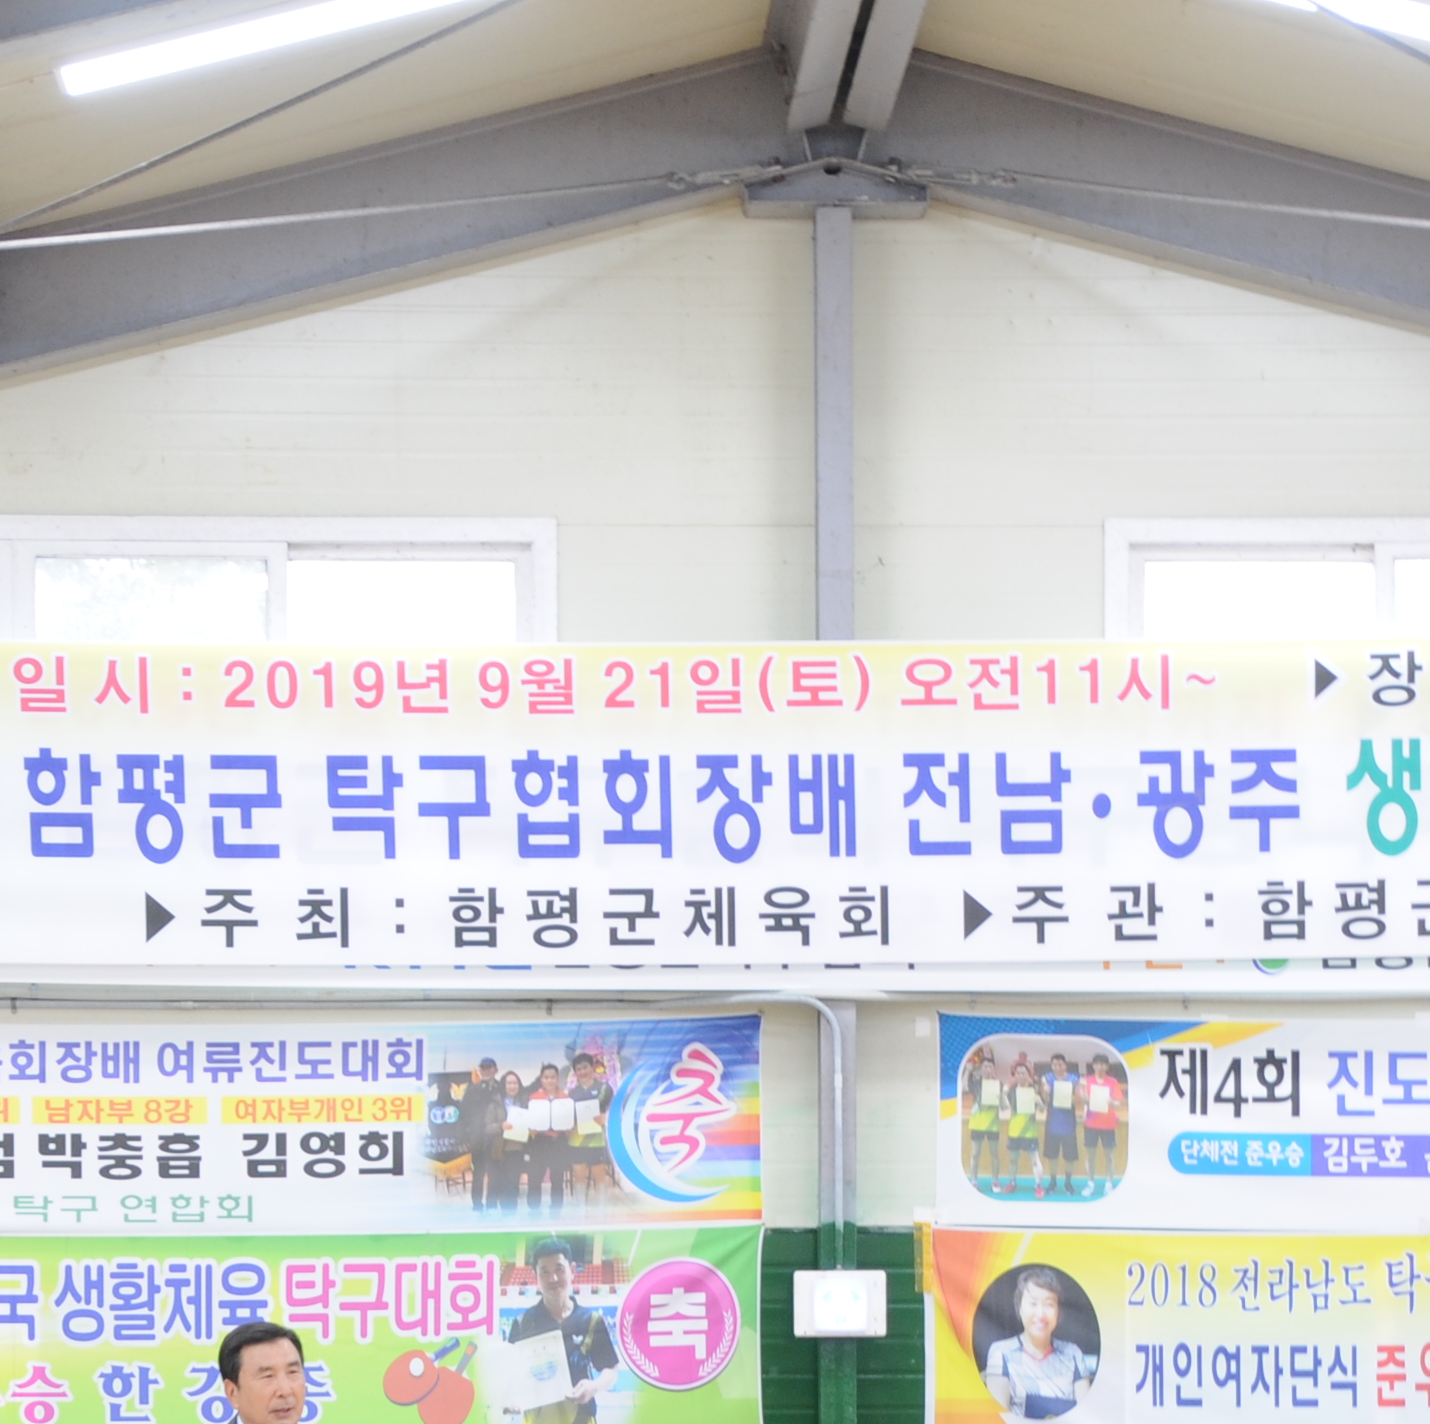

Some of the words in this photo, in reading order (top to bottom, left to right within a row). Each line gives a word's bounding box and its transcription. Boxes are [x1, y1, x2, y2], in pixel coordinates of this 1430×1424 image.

[223, 657, 451, 715] 2019년
[478, 656, 576, 715] 9월
[603, 654, 873, 715] 21일(토)
[23, 747, 283, 865] 함평군
[325, 748, 858, 865] 탁구협회장배
[902, 748, 1301, 859] 전남·광주
[447, 882, 892, 950] 함평군체육회
[156, 1037, 425, 1084] 여류진도대회
[1159, 1046, 1302, 1119] 제4회
[44, 1097, 135, 1124] 남자부
[143, 1098, 193, 1124] 8강
[234, 1096, 363, 1123] 여자부개인
[371, 1096, 414, 1122] 3위
[645, 1042, 729, 1172] 축
[37, 1131, 203, 1181] 박충흡
[240, 1129, 405, 1179] 김영희
[1180, 1139, 1239, 1166] 단체전
[1244, 1140, 1305, 1169] 준우승
[1322, 1135, 1408, 1171] 김두호
[12, 1193, 101, 1223] 탁구
[119, 1193, 255, 1223] 연합회
[55, 1262, 269, 1342] 생활체육
[284, 1259, 496, 1340] 탁구대회
[1127, 1261, 1218, 1309] 2018
[1230, 1257, 1371, 1315] 전라남도
[646, 1288, 708, 1361] 축
[1136, 1341, 1359, 1409] 개인여자단식
